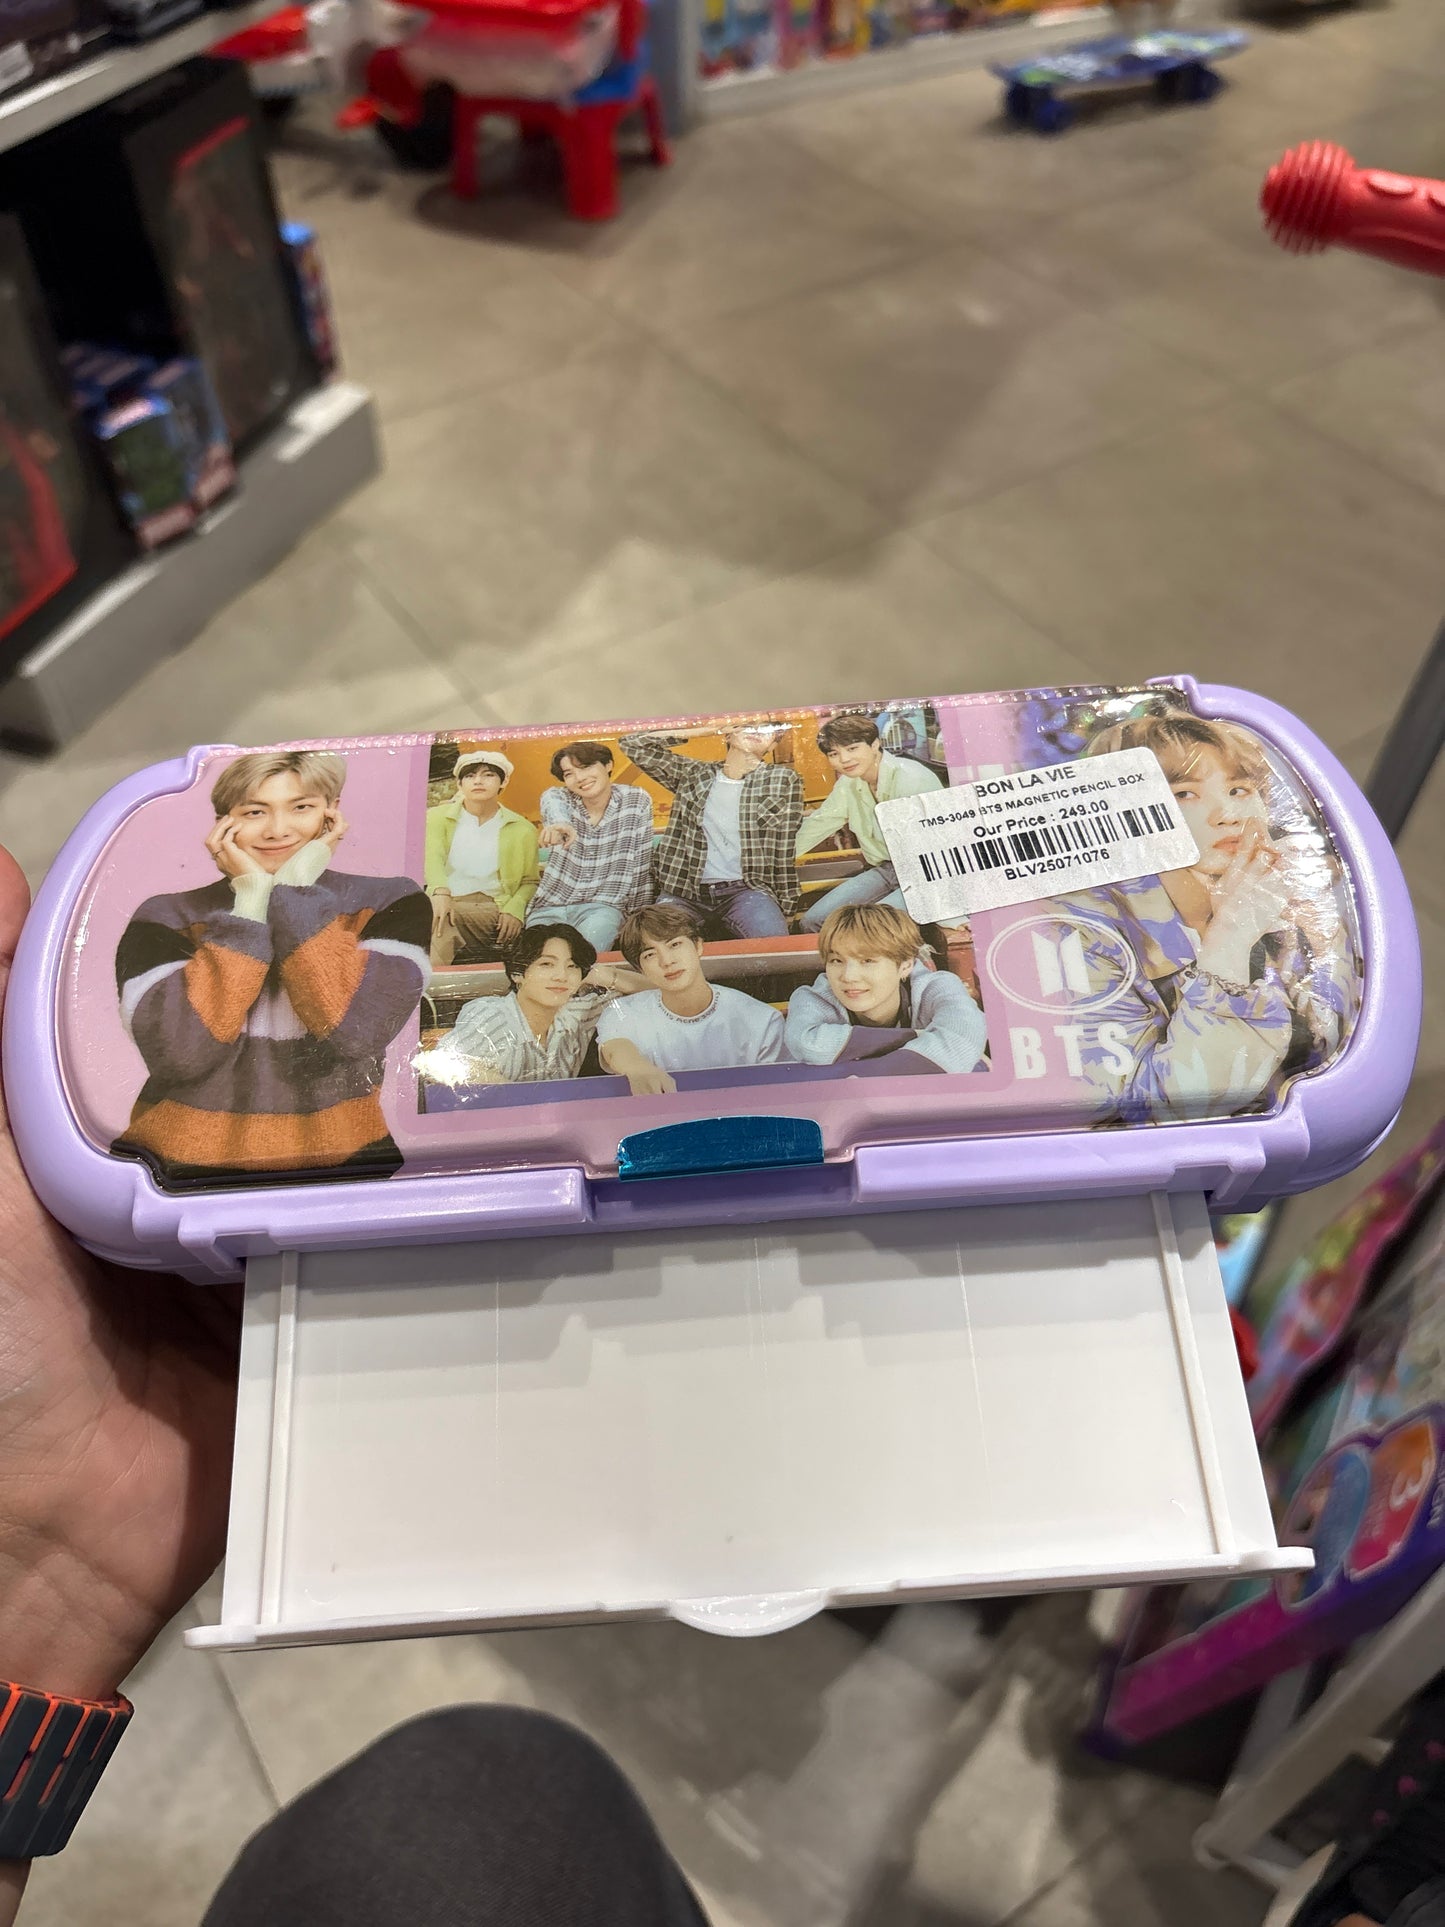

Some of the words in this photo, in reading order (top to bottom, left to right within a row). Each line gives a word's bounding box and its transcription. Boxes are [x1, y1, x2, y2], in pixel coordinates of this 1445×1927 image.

[918, 809, 976, 829] TMS-3049
[978, 803, 1003, 816] BTS
[1005, 790, 1070, 810] MAGNETIC
[1071, 780, 1116, 798] PENCIL
[1118, 773, 1146, 786] BOX
[975, 778, 1014, 798] BON
[1018, 773, 1043, 788] LA
[1045, 766, 1077, 782] VIE
[973, 823, 1005, 839] Our
[1007, 813, 1047, 832] Price
[1058, 799, 1110, 820] 249.00
[1004, 848, 1111, 881] BLV25071076
[1009, 1021, 1137, 1080] BTS
